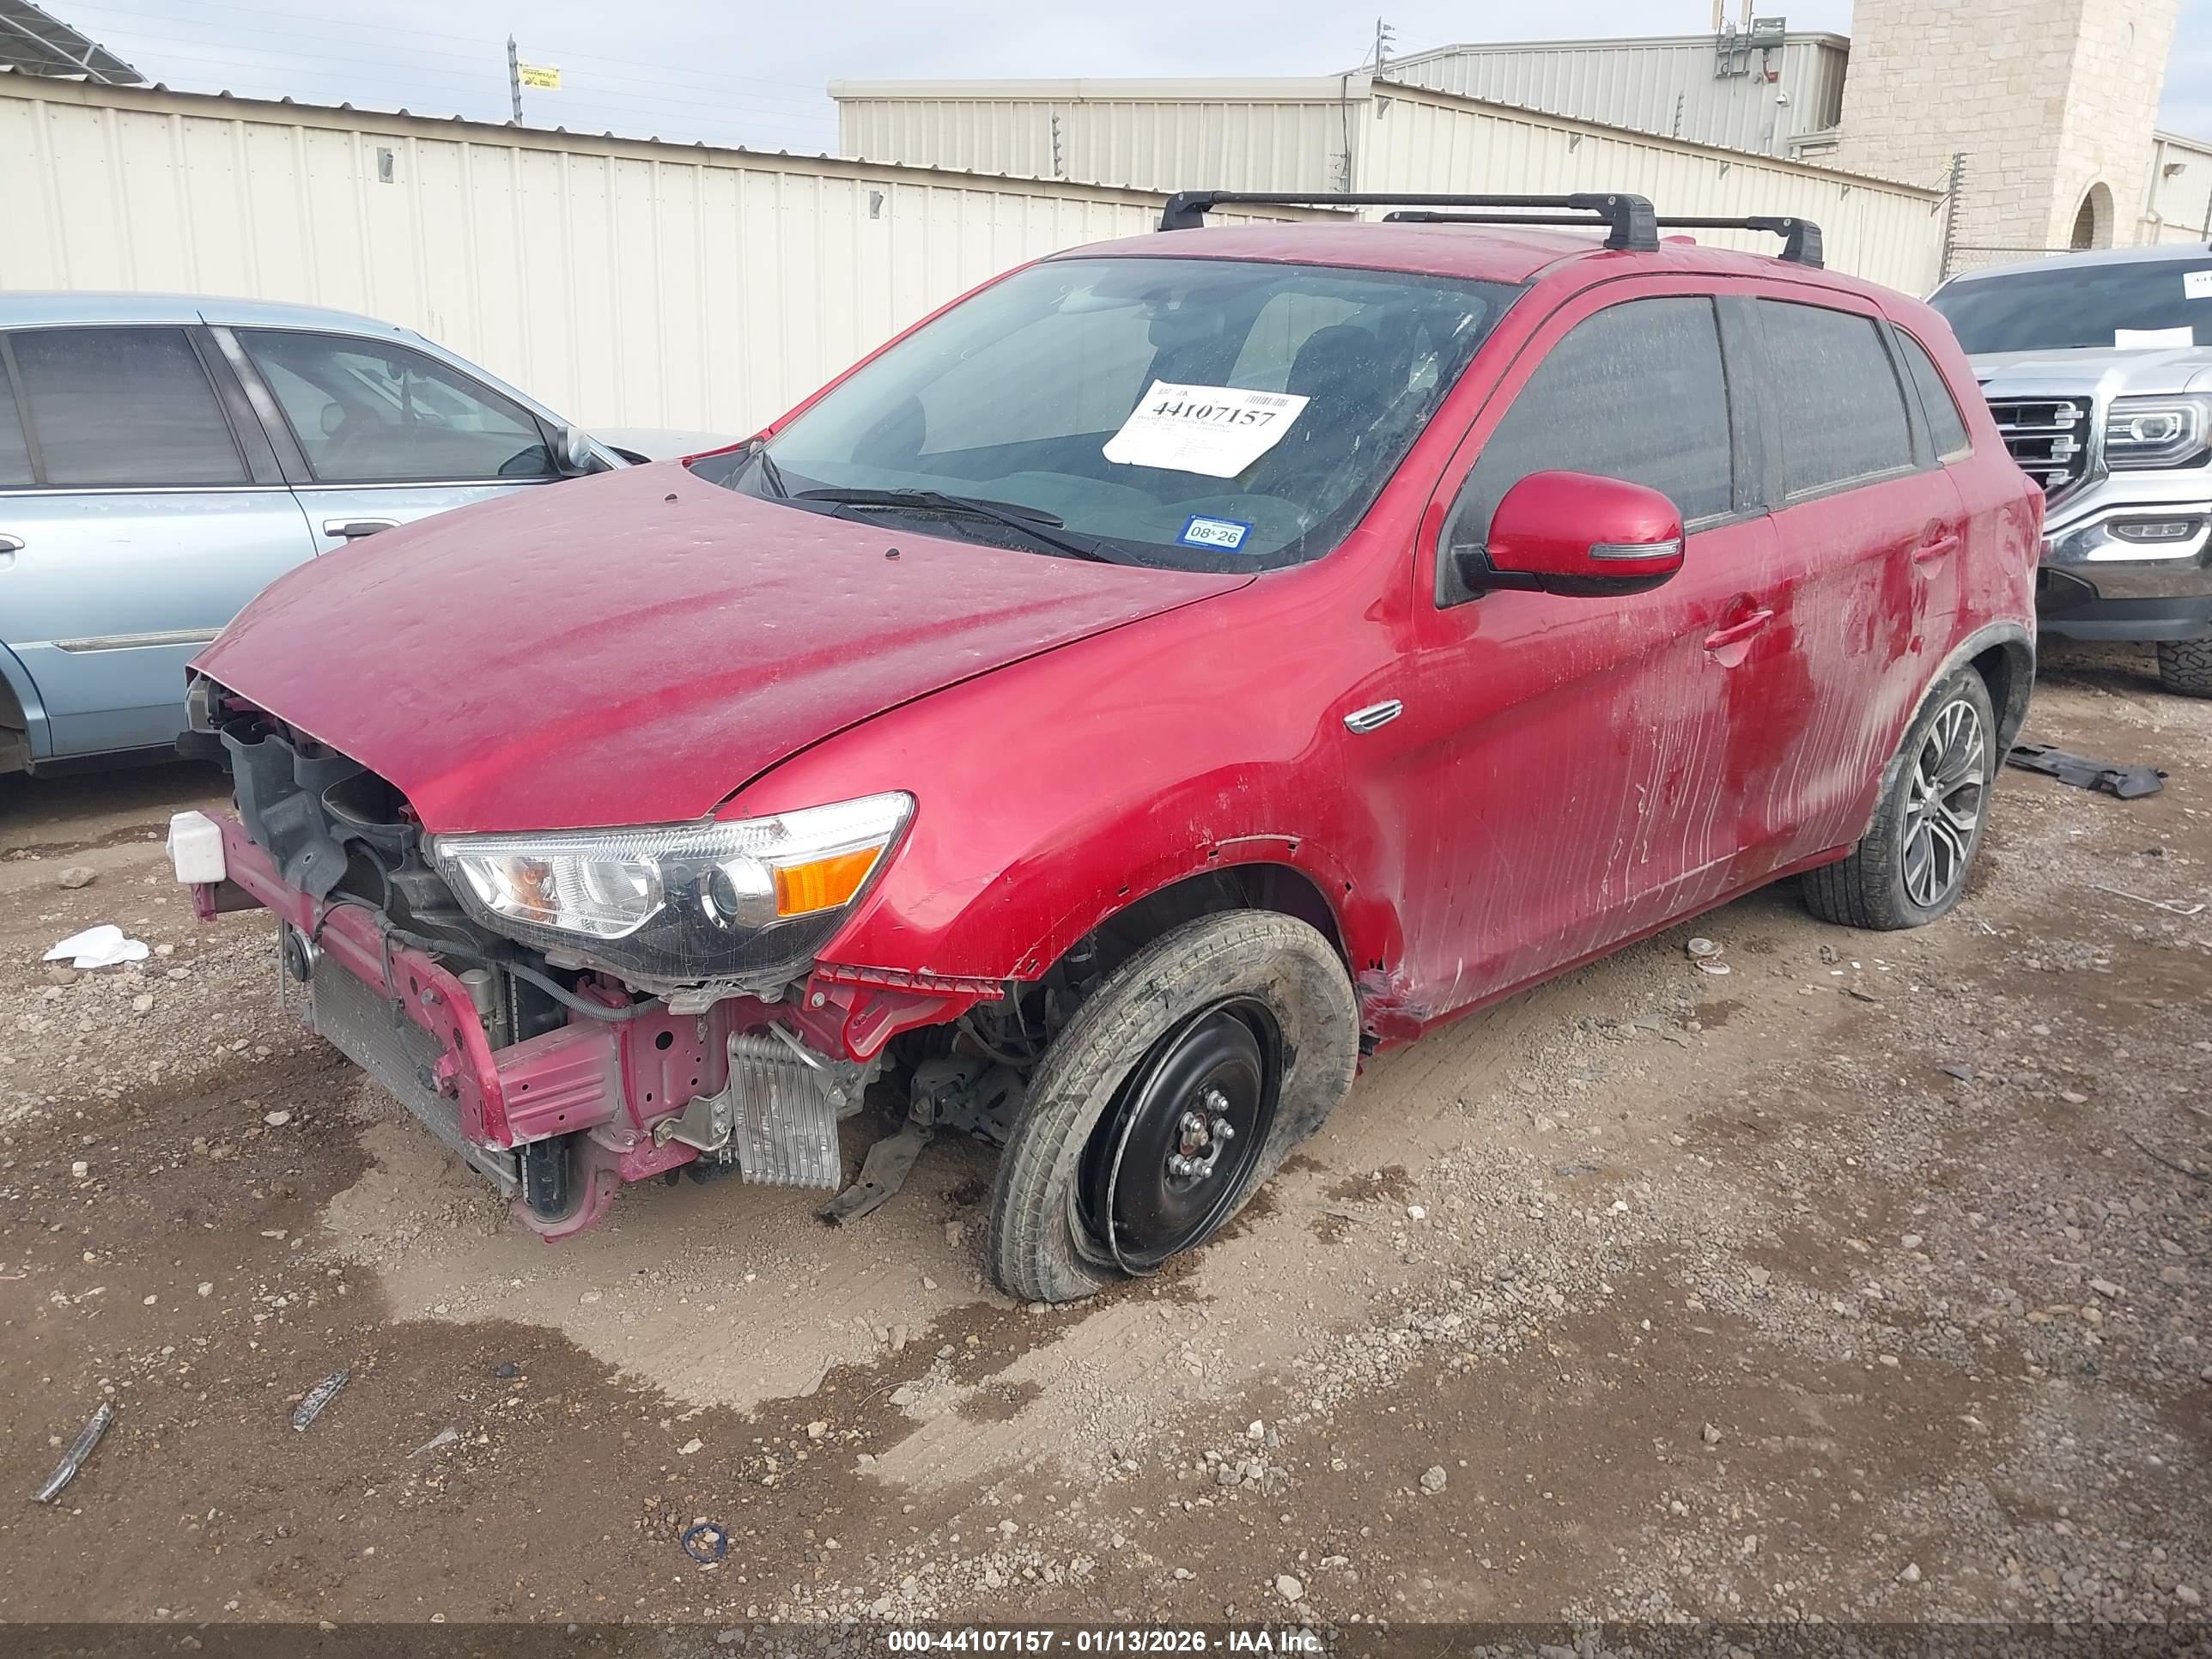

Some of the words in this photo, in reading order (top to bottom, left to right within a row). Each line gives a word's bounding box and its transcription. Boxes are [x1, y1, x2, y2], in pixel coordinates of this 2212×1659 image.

[1152, 401, 1277, 427] 44107157
[1190, 526, 1212, 538] 08
[1216, 531, 1238, 544] 26
